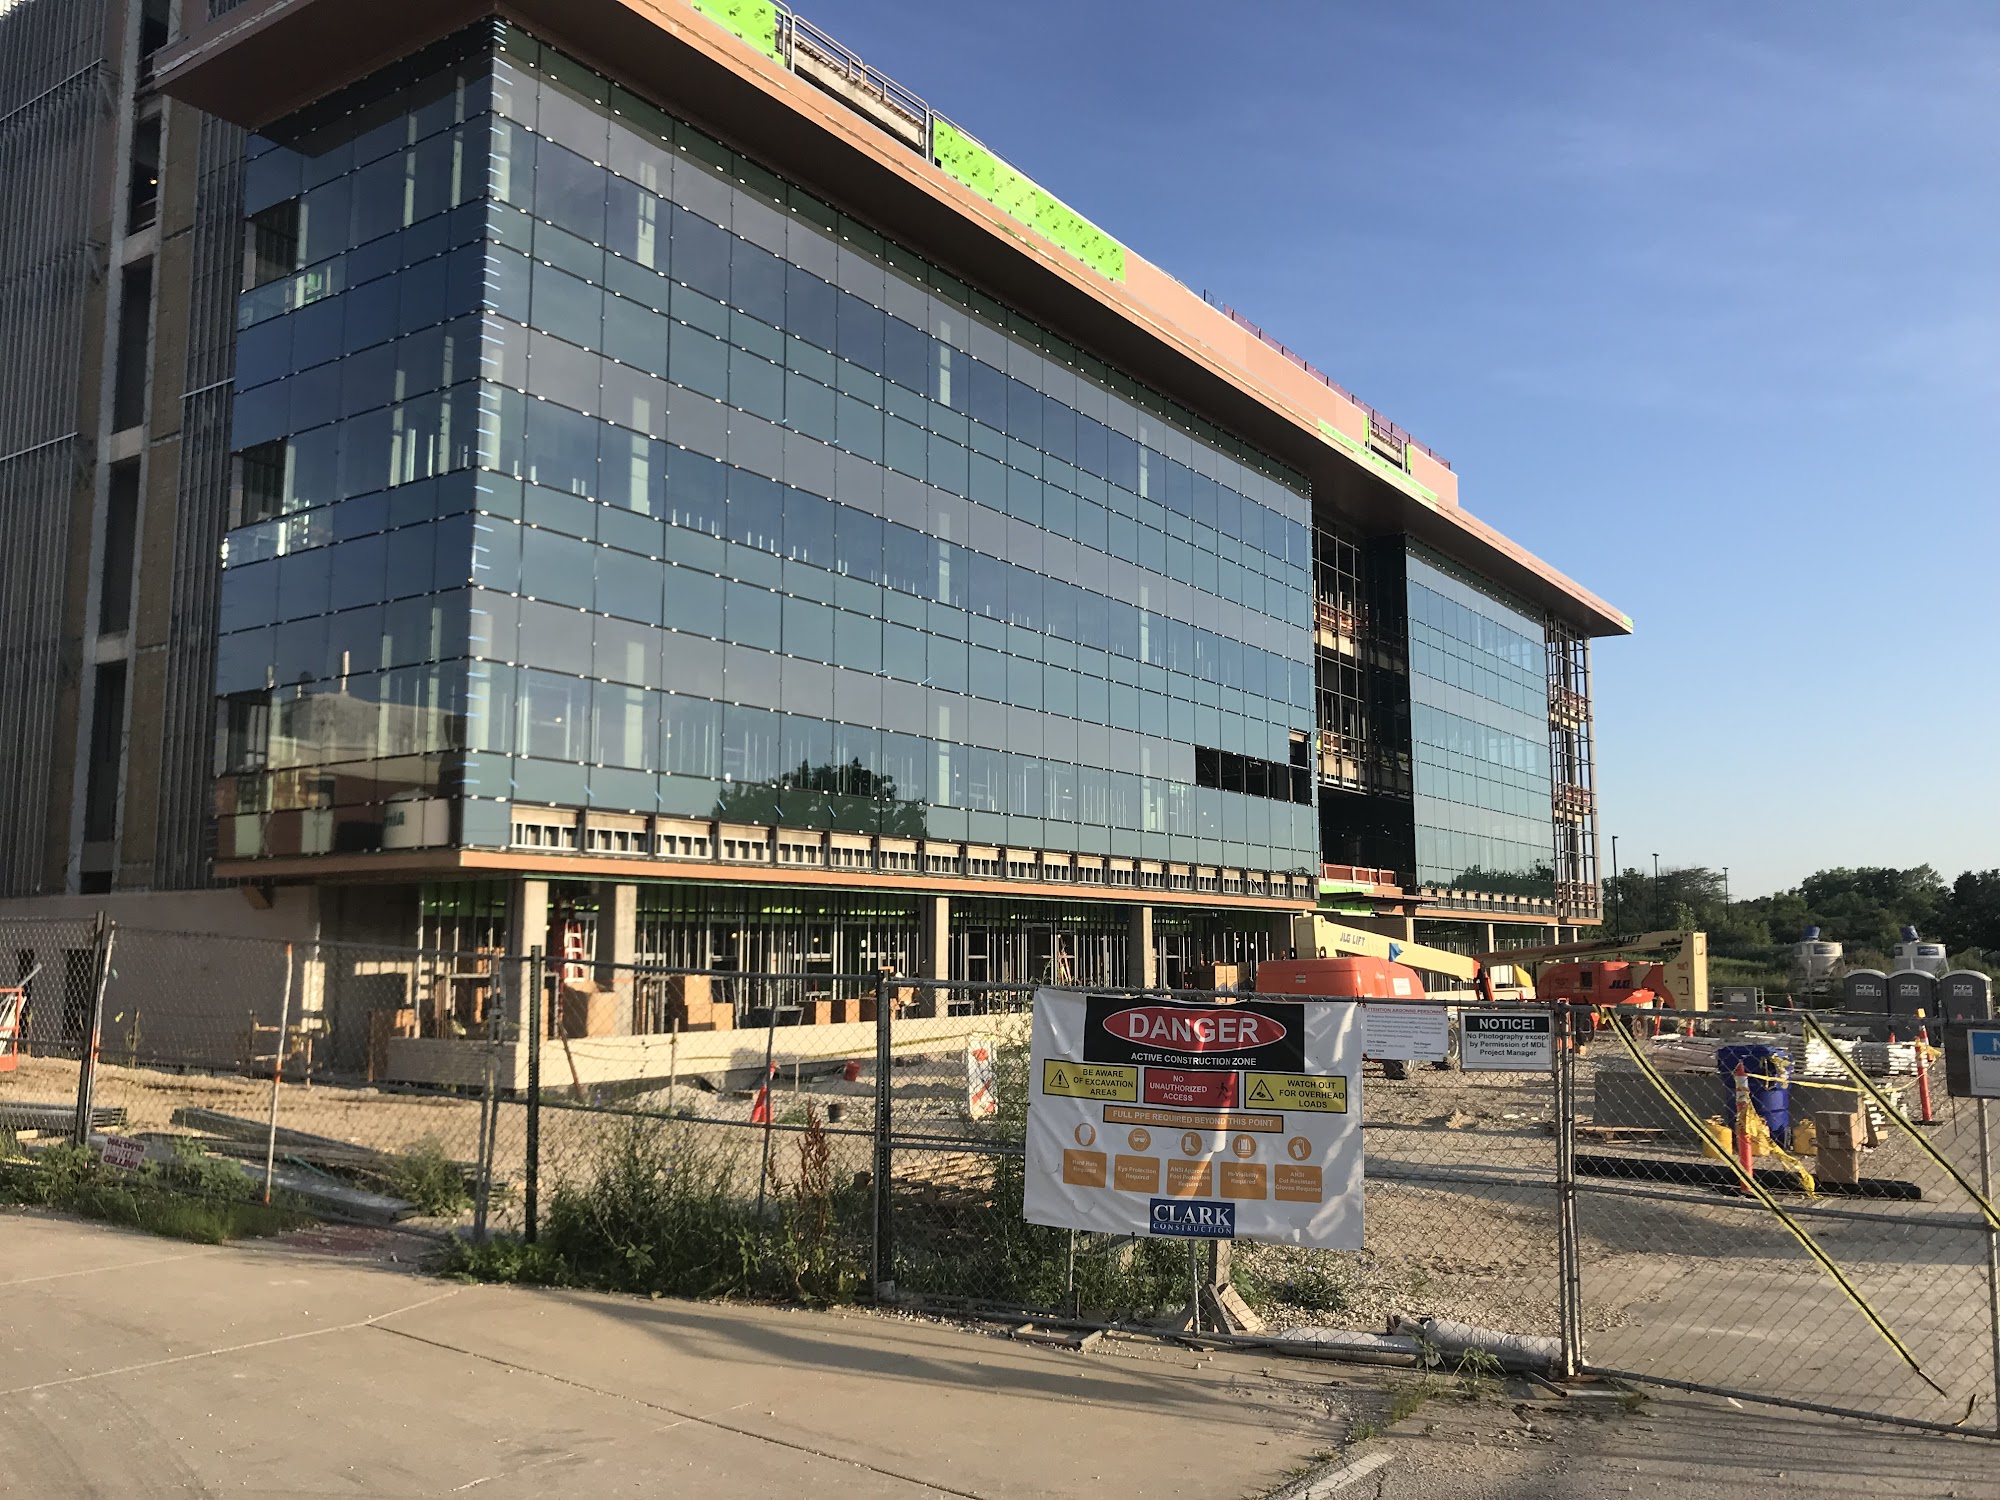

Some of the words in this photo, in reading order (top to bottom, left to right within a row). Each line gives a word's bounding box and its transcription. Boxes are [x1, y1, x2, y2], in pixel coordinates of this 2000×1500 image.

[1352, 934, 1365, 946] LIFT
[1129, 1013, 1259, 1043] DANGER
[1479, 1018, 1535, 1030] NOTICE!
[1131, 1052, 1162, 1062] ACTIVE
[1164, 1054, 1231, 1065] CONSTRUCTION
[1232, 1057, 1257, 1066] ZONE
[1082, 1068, 1094, 1076] BE
[1095, 1069, 1124, 1078] AWARE
[1073, 1076, 1083, 1084] OF
[1085, 1078, 1134, 1088] EXCAVATION
[1287, 1080, 1316, 1089] WATCH
[1318, 1081, 1336, 1089] OUT
[1090, 1088, 1117, 1096] AREAS
[1149, 1082, 1208, 1093] UNAUTHORIZED
[1163, 1092, 1193, 1101] ACCESS
[1279, 1089, 1296, 1097] FOR
[1298, 1090, 1345, 1099] OVERHEAD
[1298, 1100, 1328, 1108] LOADS
[1113, 1109, 1132, 1119] FULL
[1134, 1111, 1150, 1120] PPE
[1152, 1113, 1193, 1123] REQUIRED
[1194, 1116, 1227, 1125] BEYOND
[1229, 1117, 1246, 1126] THIS
[1248, 1118, 1274, 1127] POINT
[1117, 1165, 1128, 1173] Eye
[1128, 1166, 1157, 1174] Protection
[1125, 1173, 1150, 1181] Required
[1178, 1180, 1203, 1188] Required
[1296, 1185, 1322, 1193] Required
[1153, 1204, 1231, 1226] CLARK
[1153, 1223, 1232, 1234] CONSTRUCTION
